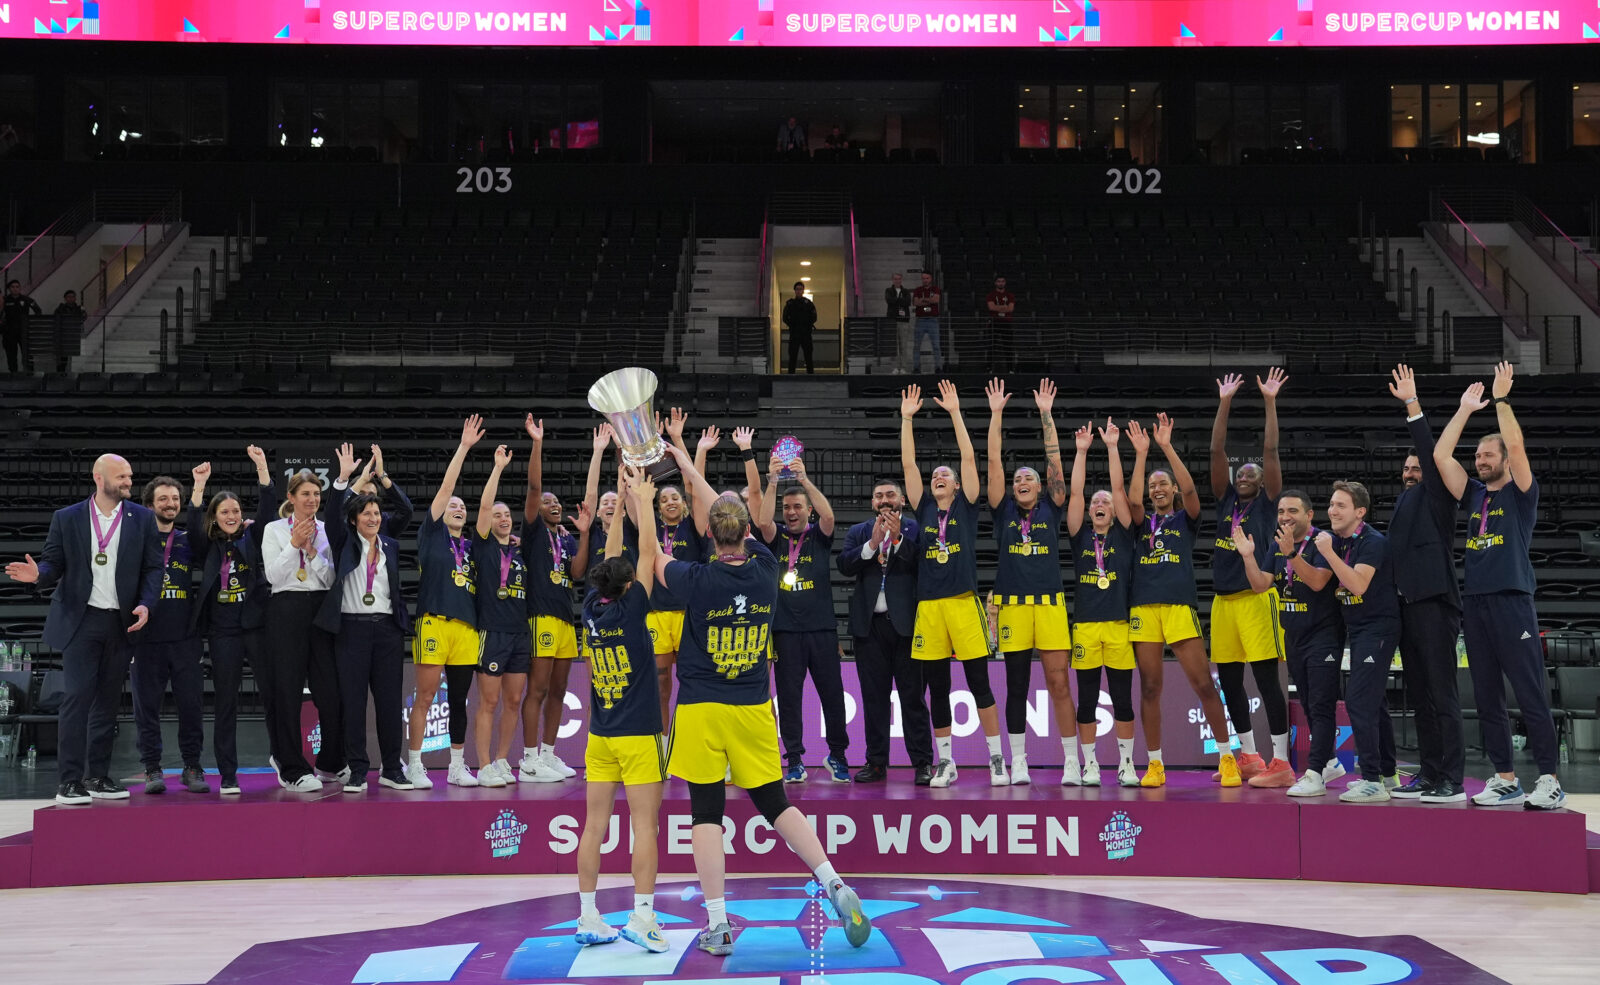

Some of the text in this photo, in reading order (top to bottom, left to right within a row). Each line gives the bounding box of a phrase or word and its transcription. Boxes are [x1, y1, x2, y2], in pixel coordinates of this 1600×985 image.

[332, 11, 567, 32] SUPERCUP WOMEN
[786, 13, 1017, 33] SUPERCUP WOMEN
[1325, 10, 1560, 32] SUPERCUP WOMEN
[456, 166, 513, 193] 203
[1105, 168, 1162, 194] 202
[284, 467, 330, 492] 13
[706, 599, 771, 621] Back 2 Back
[599, 627, 625, 638] Back
[484, 823, 529, 840] SUPERCUP
[491, 835, 521, 849] WOMEN
[872, 813, 1080, 857] WOMEN
[1098, 825, 1143, 842] SUPERCUP
[1105, 837, 1136, 851] WOMEN
